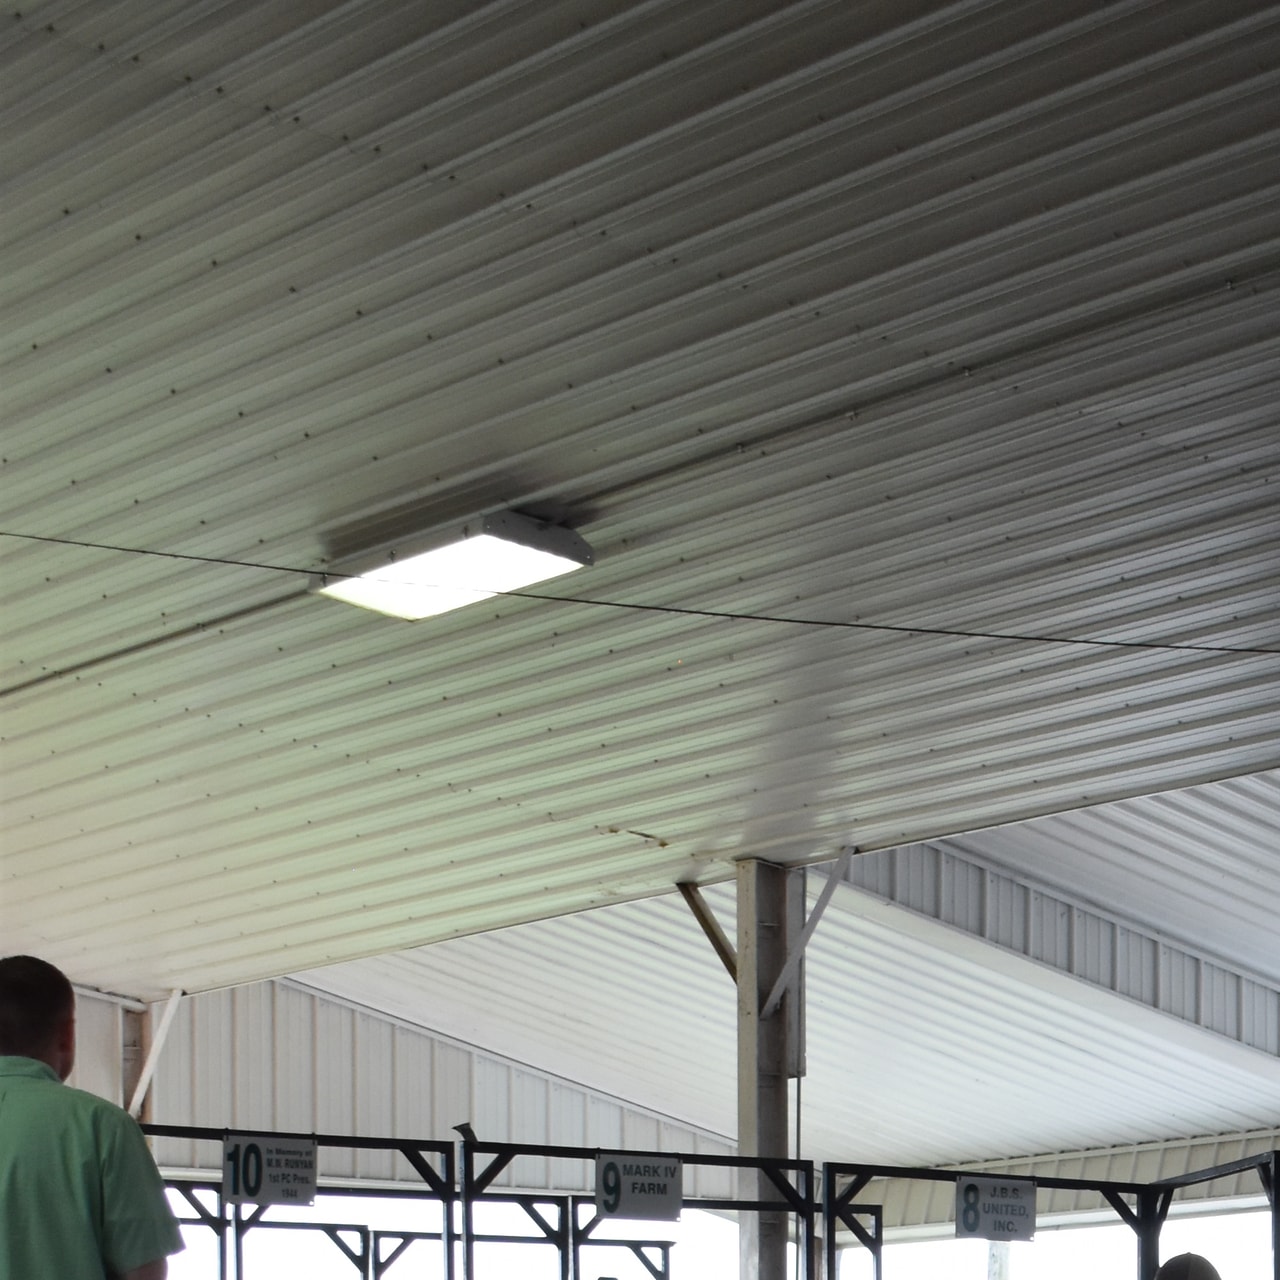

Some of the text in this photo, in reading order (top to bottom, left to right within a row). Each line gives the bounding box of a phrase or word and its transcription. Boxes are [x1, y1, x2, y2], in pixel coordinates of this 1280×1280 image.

[275, 1148, 303, 1157] Memory
[226, 1143, 262, 1197] 10
[284, 1159, 313, 1169] RUNYAN
[623, 1164, 677, 1178] MARK IV
[602, 1162, 621, 1213] 9
[631, 1182, 667, 1195] FARM
[990, 1186, 1023, 1199] J.B.S.
[963, 1183, 980, 1232] 8
[983, 1203, 1029, 1219] UNITED,
[993, 1220, 1018, 1232] INC.
